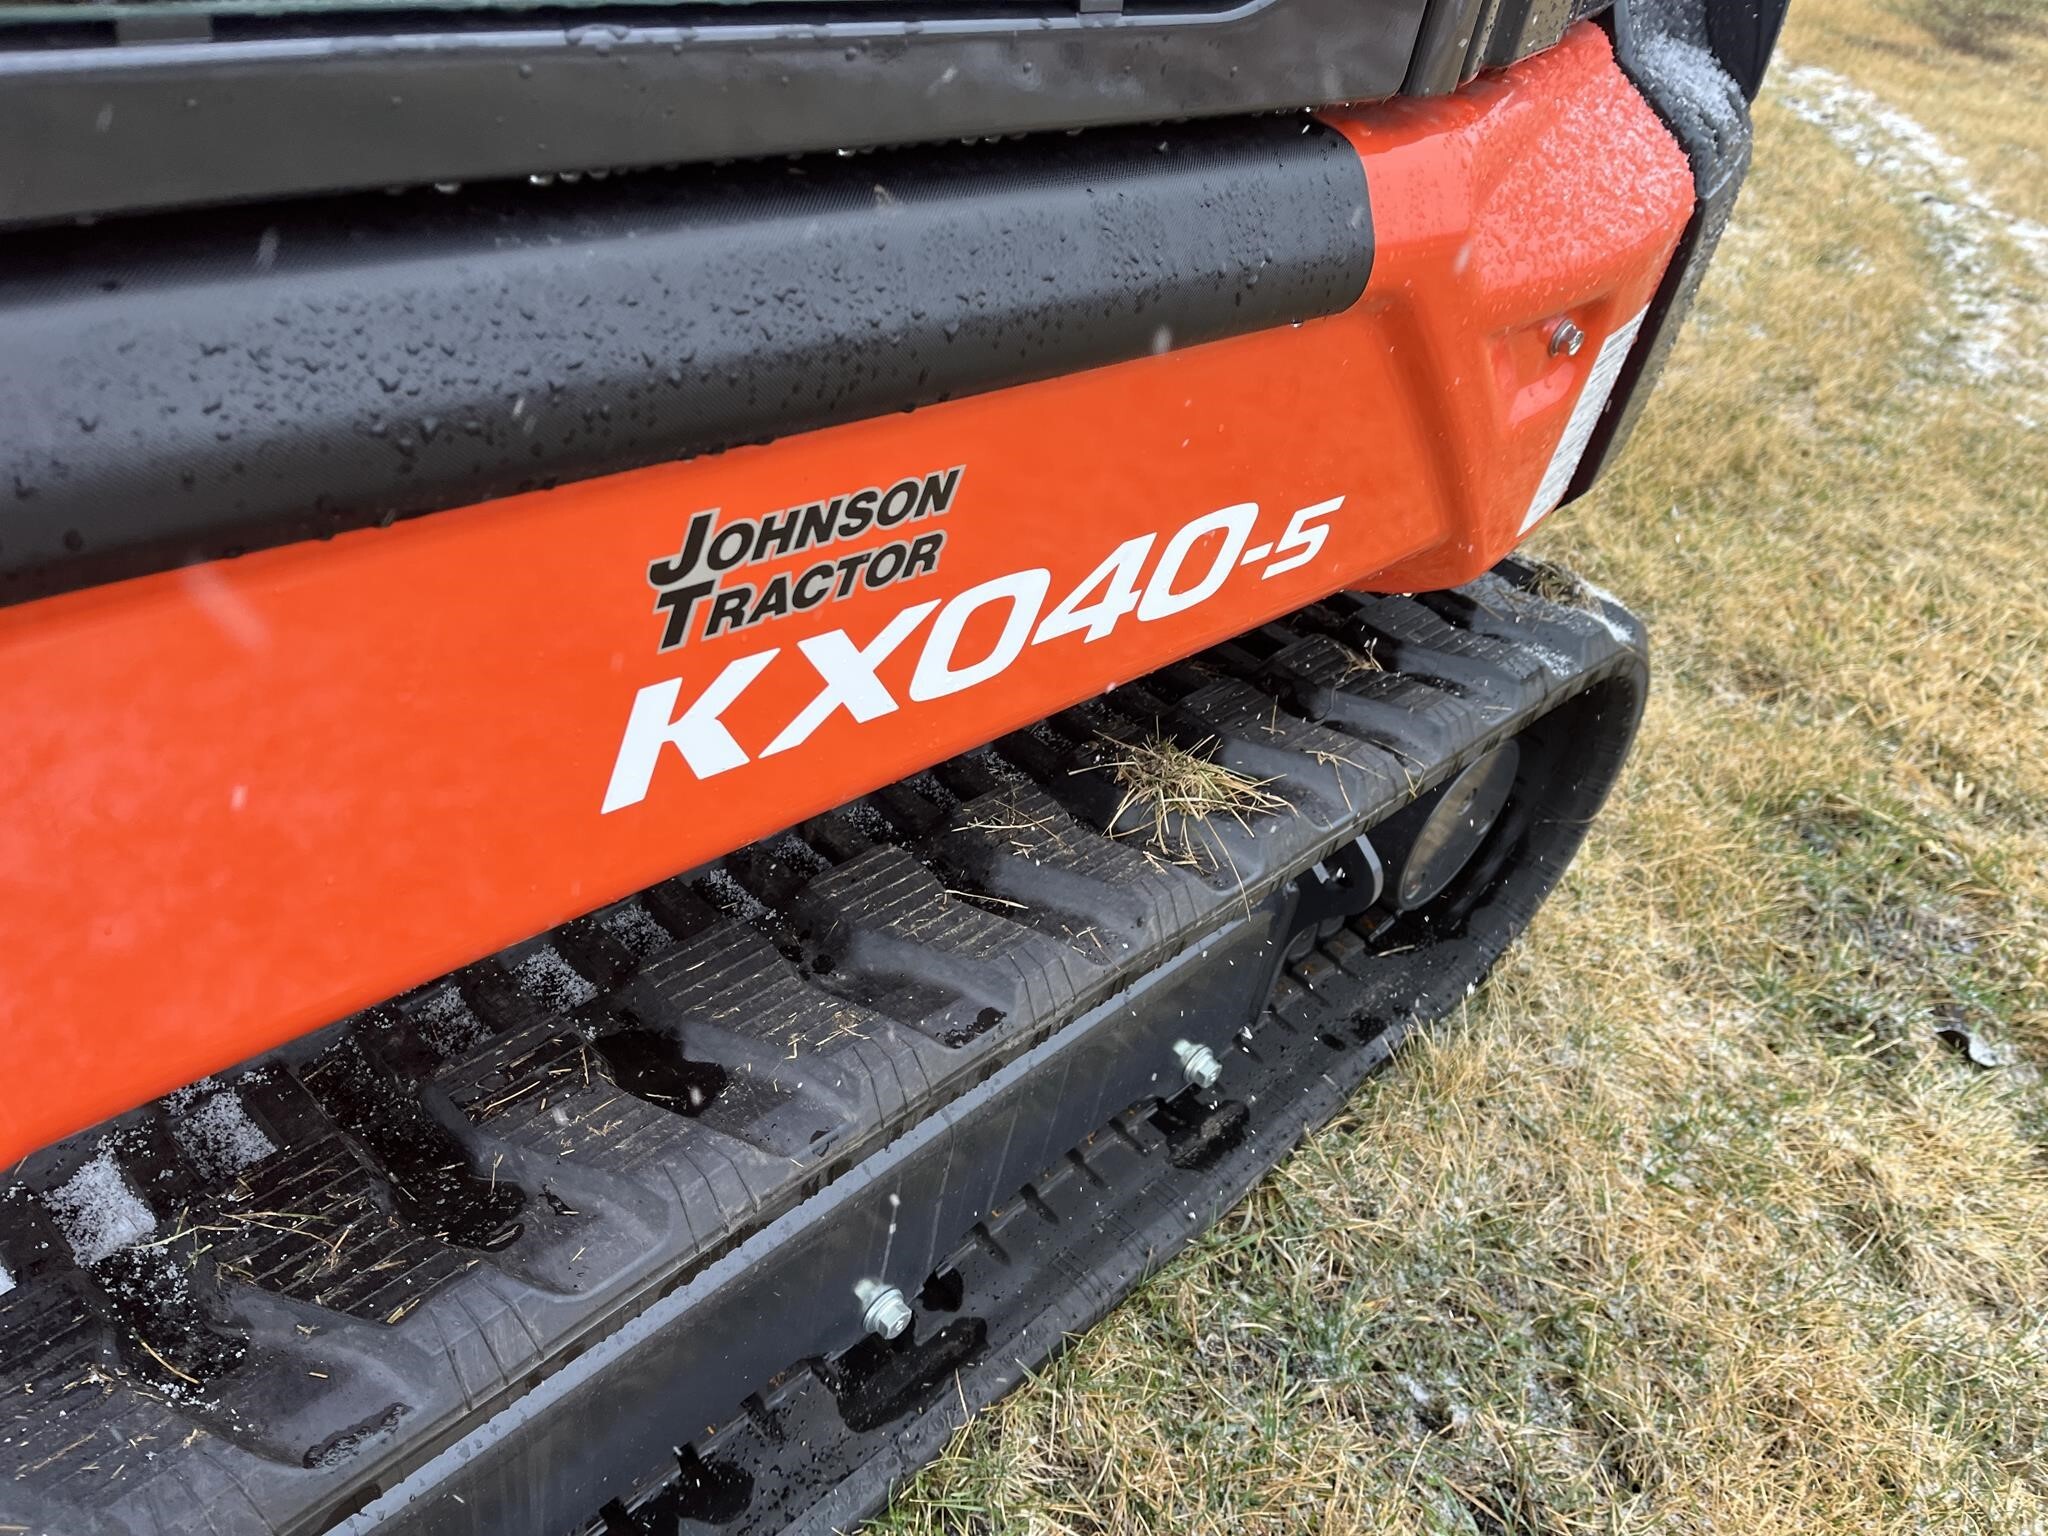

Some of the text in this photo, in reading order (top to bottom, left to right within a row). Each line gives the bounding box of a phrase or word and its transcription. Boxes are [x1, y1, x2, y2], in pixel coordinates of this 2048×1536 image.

[648, 466, 964, 588] JOHNSON
[656, 532, 946, 652] TRACTOR
[601, 496, 1345, 814] KX040-5
